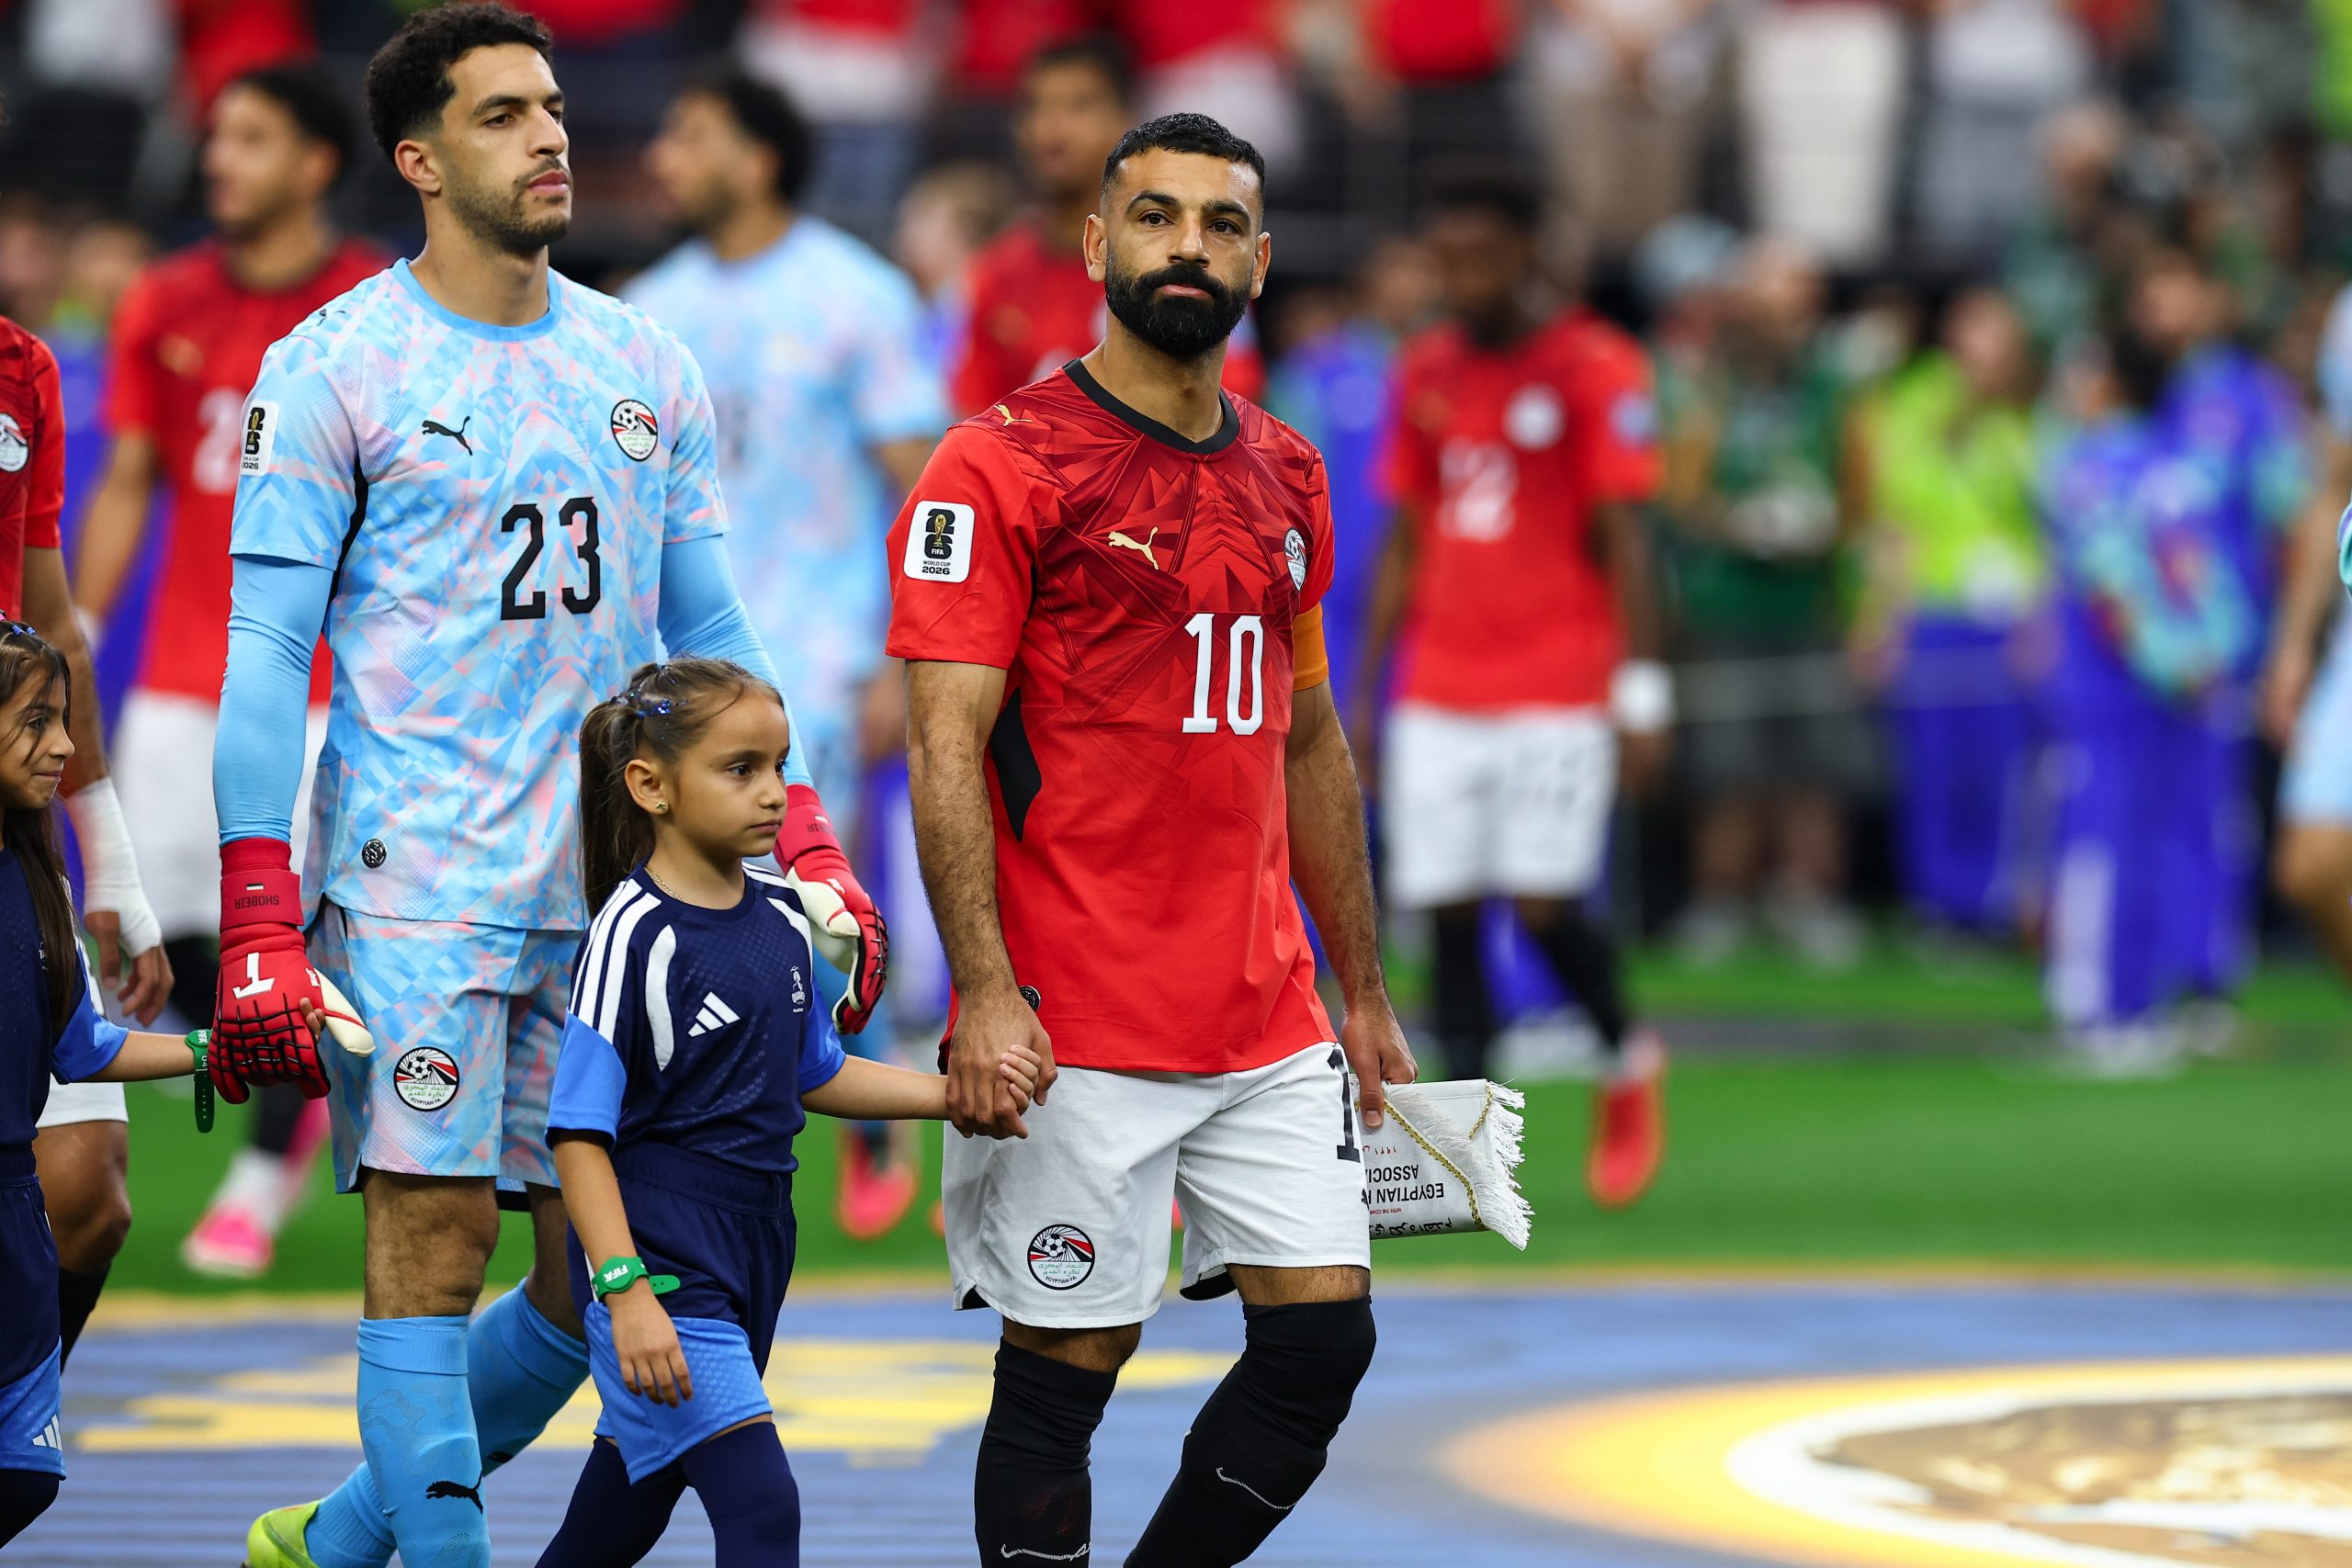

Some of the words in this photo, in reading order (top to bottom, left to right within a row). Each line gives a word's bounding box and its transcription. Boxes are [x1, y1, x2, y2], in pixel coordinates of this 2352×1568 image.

[501, 497, 601, 620] 23
[922, 566, 950, 575] 2026
[1182, 613, 1264, 735] 10
[234, 895, 280, 909] SHOBEIR
[198, 1030, 208, 1043] FIFA
[1376, 1182, 1444, 1203] EGYPTIAN
[603, 1264, 629, 1283] FIFA
